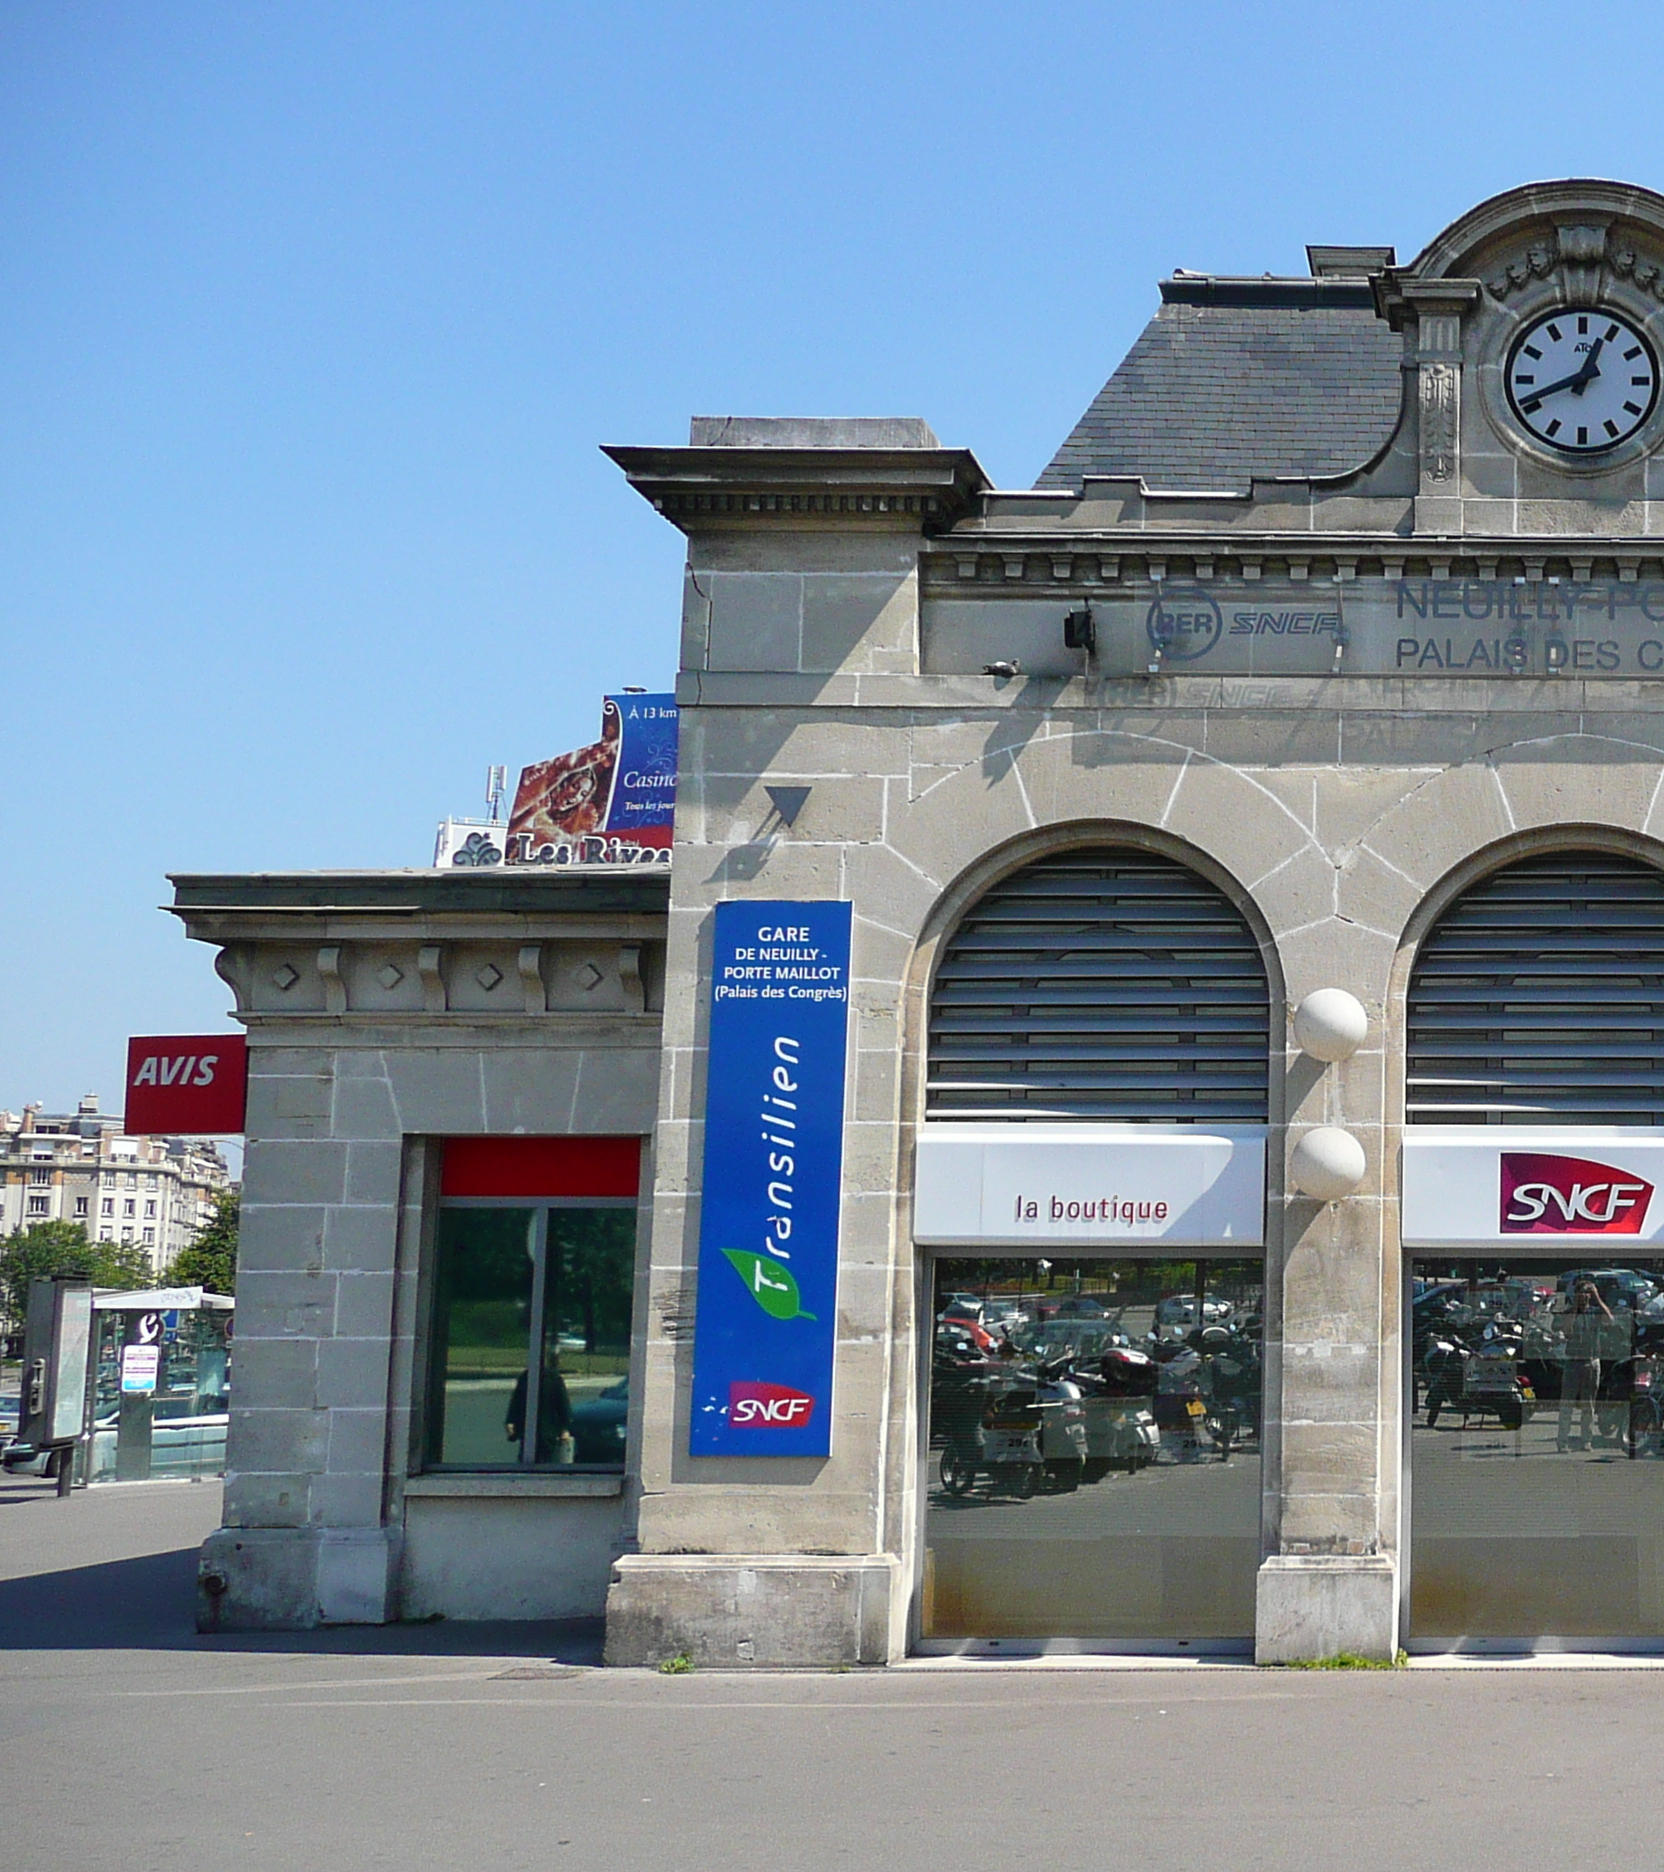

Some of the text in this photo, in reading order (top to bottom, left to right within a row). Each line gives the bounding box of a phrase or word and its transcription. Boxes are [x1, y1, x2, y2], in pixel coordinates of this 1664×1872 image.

[1157, 611, 1343, 635] RER SNCF
[1396, 637, 1528, 669] PALAIS
[1544, 639, 1622, 671] DES
[643, 707, 657, 719] 13
[659, 707, 677, 719] km
[516, 833, 674, 865] Les Rives
[757, 926, 811, 942] GARE
[734, 947, 756, 961] DE
[759, 947, 820, 961] NEUILLY
[723, 966, 841, 980] PORTE MAILLOT
[714, 984, 847, 1002] (Palais des Congrès)
[133, 1055, 219, 1086] AVIS
[754, 1035, 801, 1293] Transilien
[1016, 1194, 1168, 1226] la boutique
[1506, 1182, 1645, 1222] SNCF
[732, 1398, 810, 1423] SNCF
